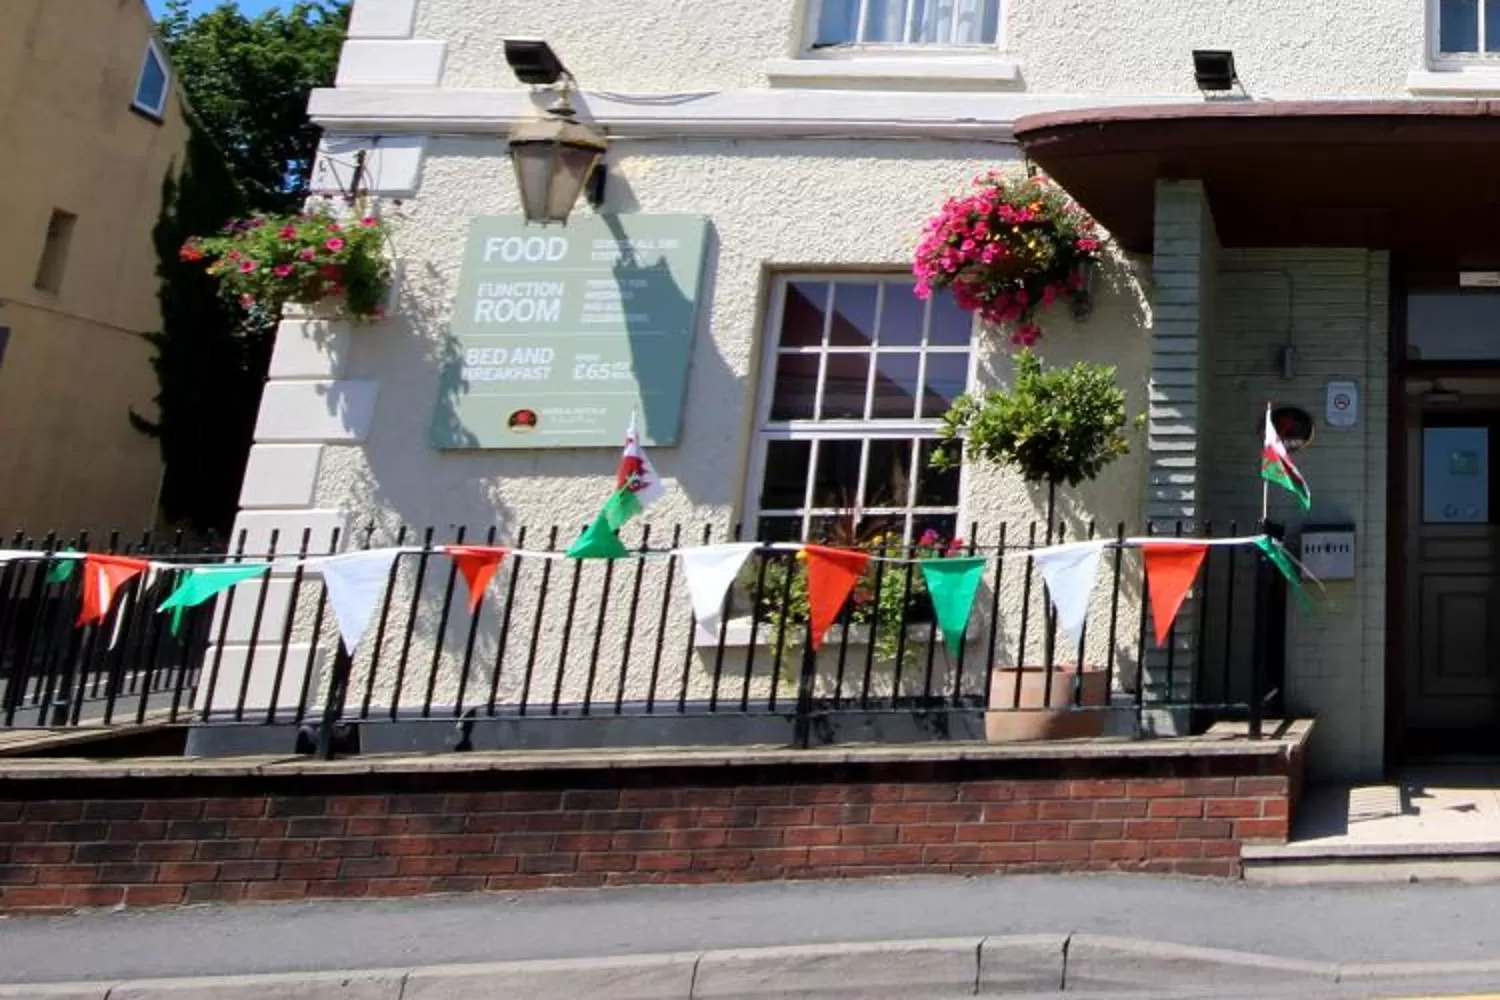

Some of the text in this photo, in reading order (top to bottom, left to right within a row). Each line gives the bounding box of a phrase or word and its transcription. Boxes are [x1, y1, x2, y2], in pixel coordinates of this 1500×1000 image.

[483, 236, 569, 263] FOOD
[476, 281, 565, 299] FUNCTION
[473, 299, 562, 323] ROOM
[465, 348, 555, 366] BED AND
[572, 362, 610, 381] £65
